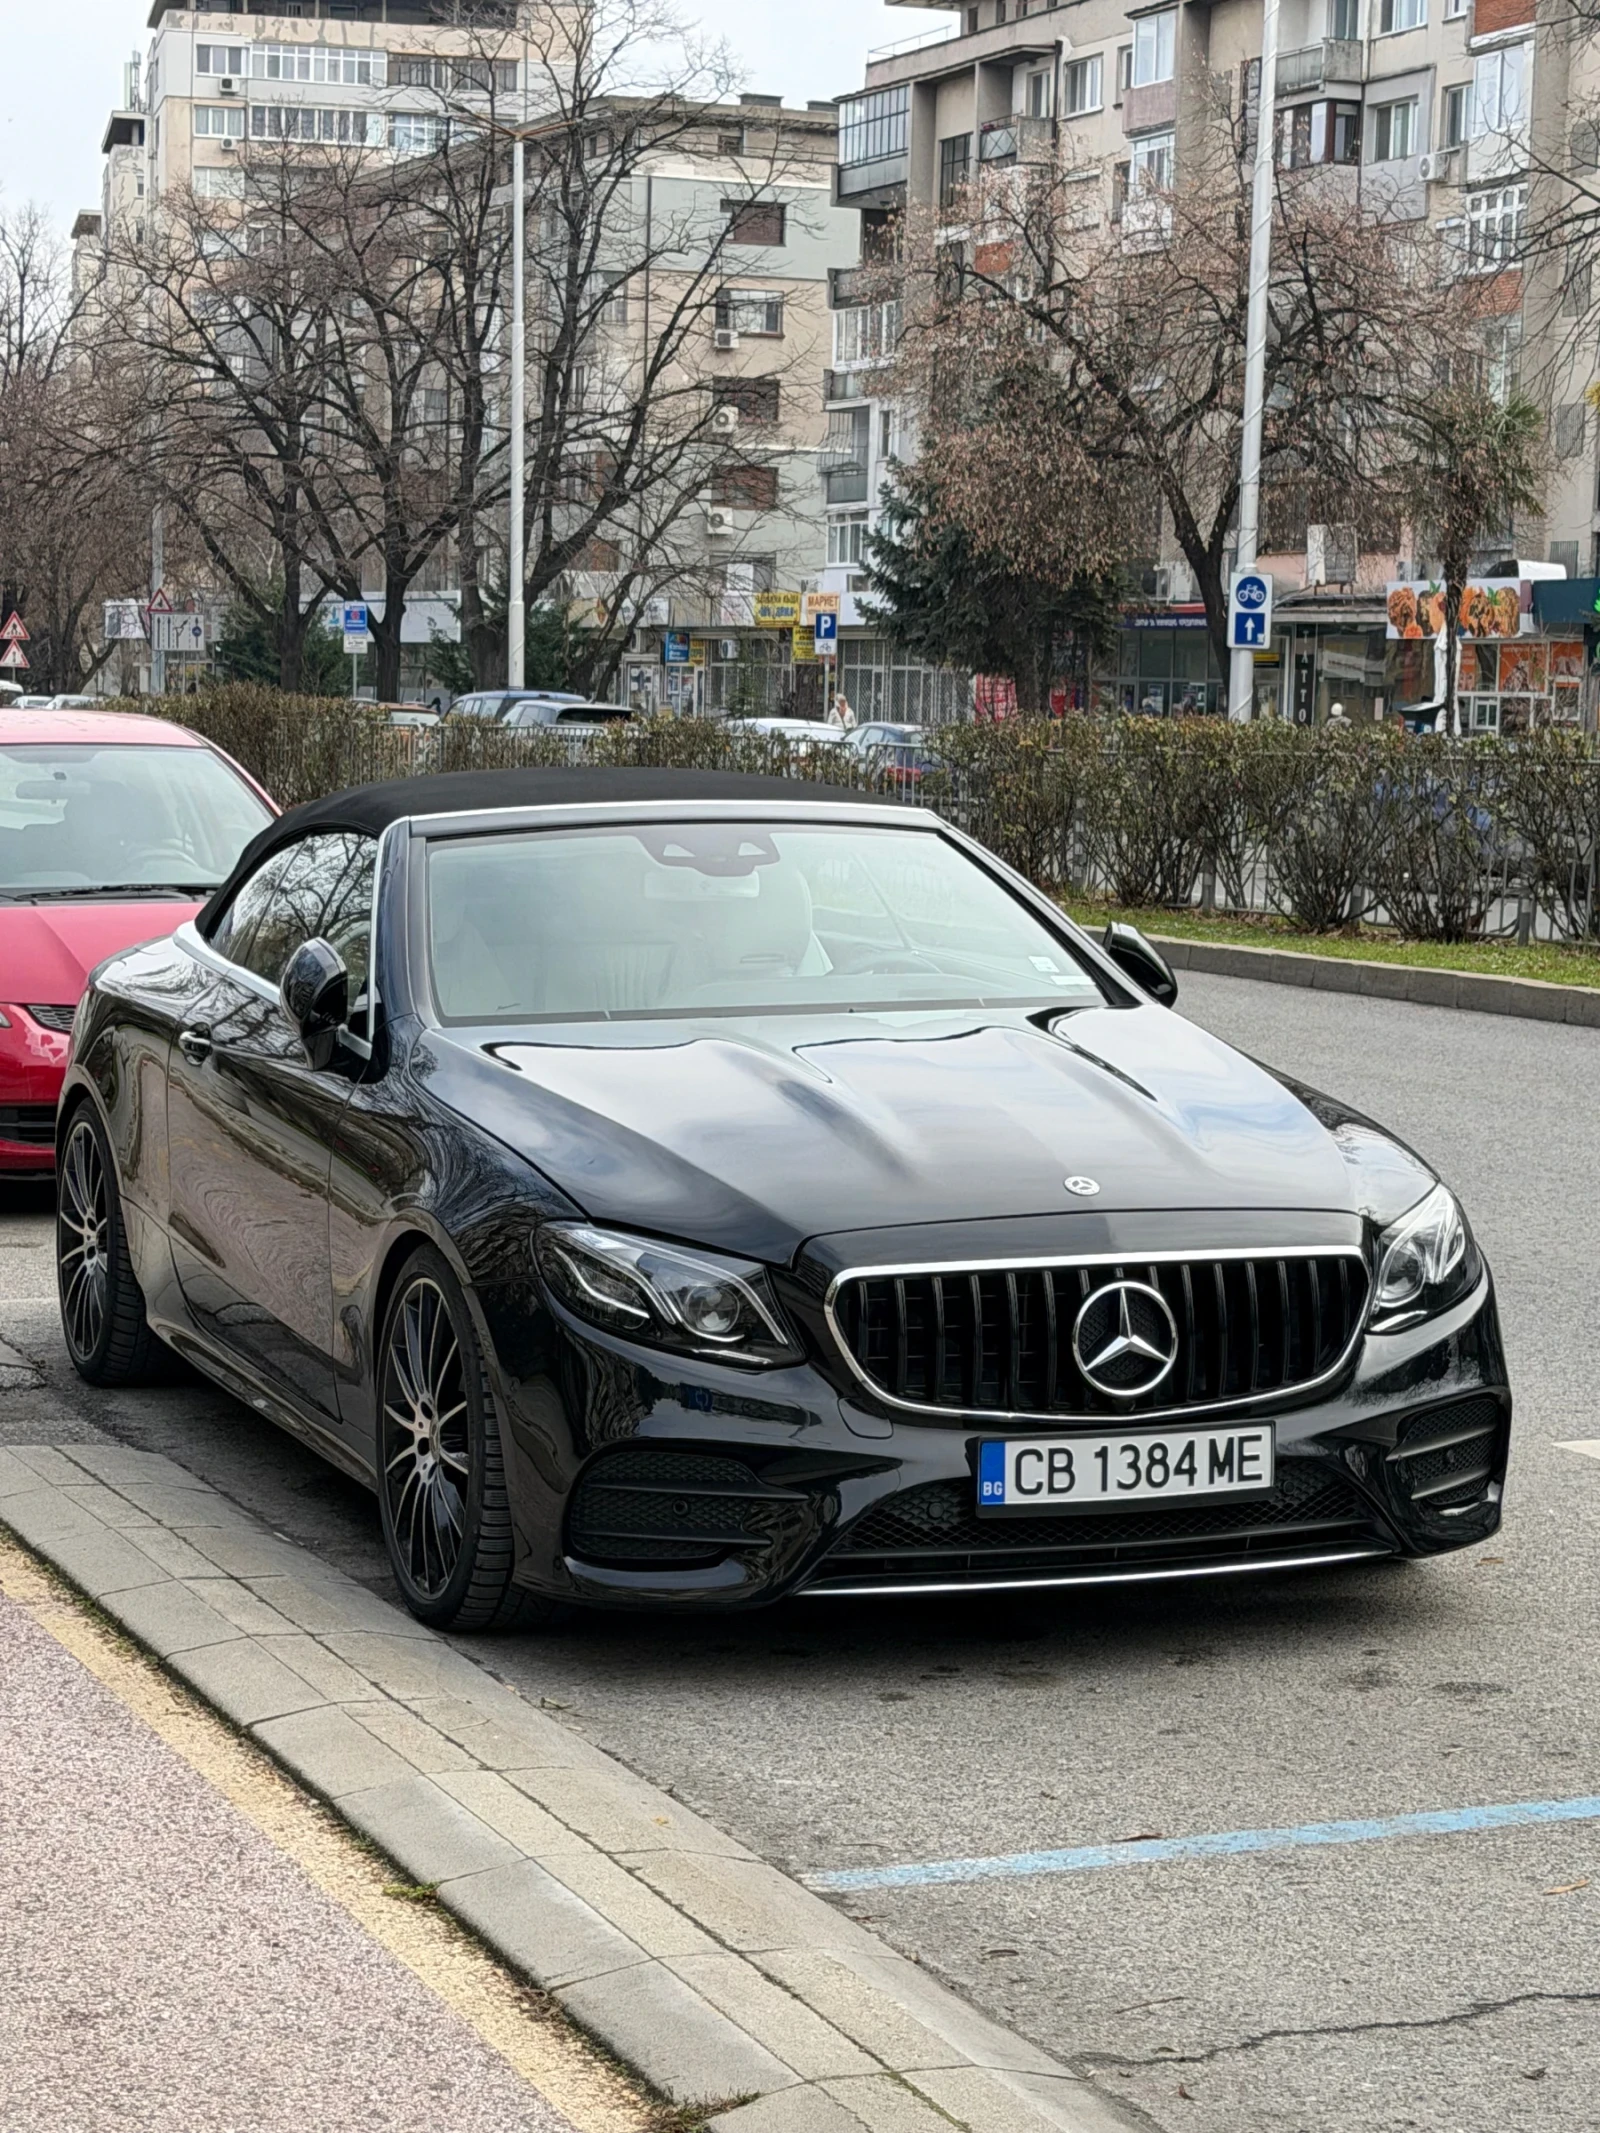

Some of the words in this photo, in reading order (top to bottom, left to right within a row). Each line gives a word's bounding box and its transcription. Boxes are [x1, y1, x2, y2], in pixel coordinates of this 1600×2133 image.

[821, 615, 832, 638] P
[1015, 1447, 1076, 1495] CB
[1093, 1439, 1198, 1492] 1384
[1208, 1434, 1263, 1485] ME
[982, 1481, 1003, 1496] BG
